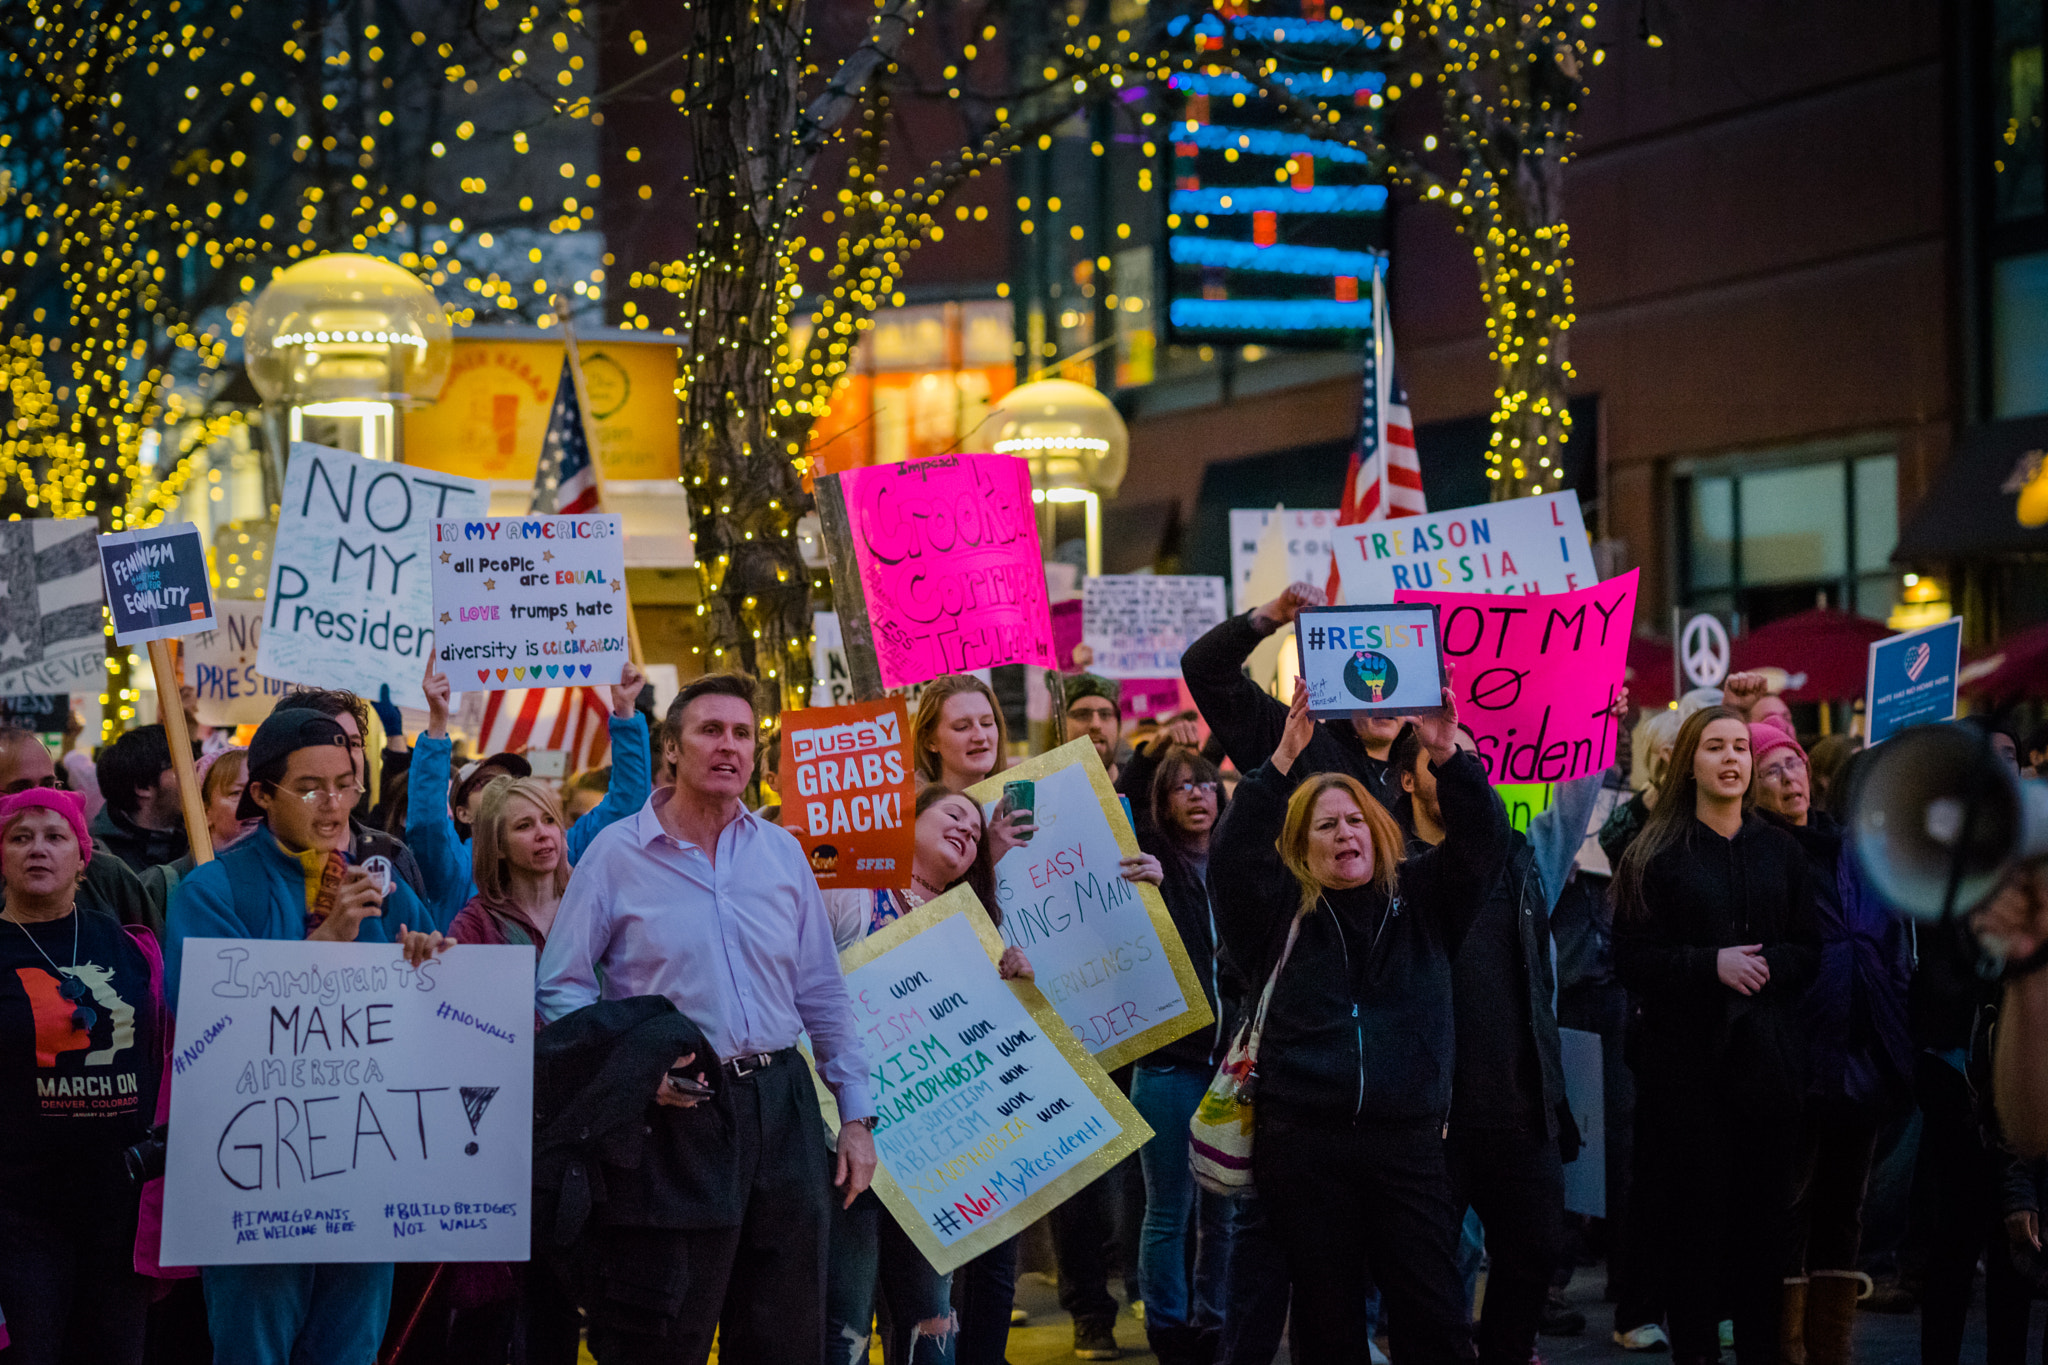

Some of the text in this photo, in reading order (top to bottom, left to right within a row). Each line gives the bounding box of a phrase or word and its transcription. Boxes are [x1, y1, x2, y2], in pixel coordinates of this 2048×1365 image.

[301, 456, 476, 533] NOT
[437, 521, 615, 542] IN MY AMERICA:
[1355, 518, 1491, 561] TREASON
[112, 543, 174, 586] FEMINISM
[332, 537, 417, 595] MY
[454, 558, 474, 572] all
[520, 570, 606, 586] are EQUAL
[1392, 551, 1518, 590] RUSSIA
[124, 586, 190, 615] EQUALITY
[270, 564, 435, 659] Presiden
[460, 606, 500, 622] LOVE
[576, 601, 613, 616] hate
[873, 615, 917, 650] LESS
[1308, 624, 1428, 650] #RESIST
[1540, 592, 1626, 654] MY
[441, 641, 517, 661] diversity
[526, 640, 539, 656] is
[792, 720, 897, 759] PUSSY
[796, 750, 904, 797] GRABS
[806, 792, 902, 837] BACK!
[856, 858, 895, 870] SFER
[1028, 842, 1084, 889] EASY
[269, 1004, 393, 1056] MAKE
[36, 1072, 138, 1097] MARCH ON
[236, 1058, 384, 1094] AMERICA
[41, 1097, 138, 1109] DENVER, COLORADO
[217, 1086, 500, 1190] GREAT!
[894, 1110, 991, 1179] ABLEISM
[907, 1116, 1033, 1203] XENOPHOBIA
[236, 1220, 356, 1244] ARE WELCOME HERE
[439, 1218, 488, 1231] WALLS
